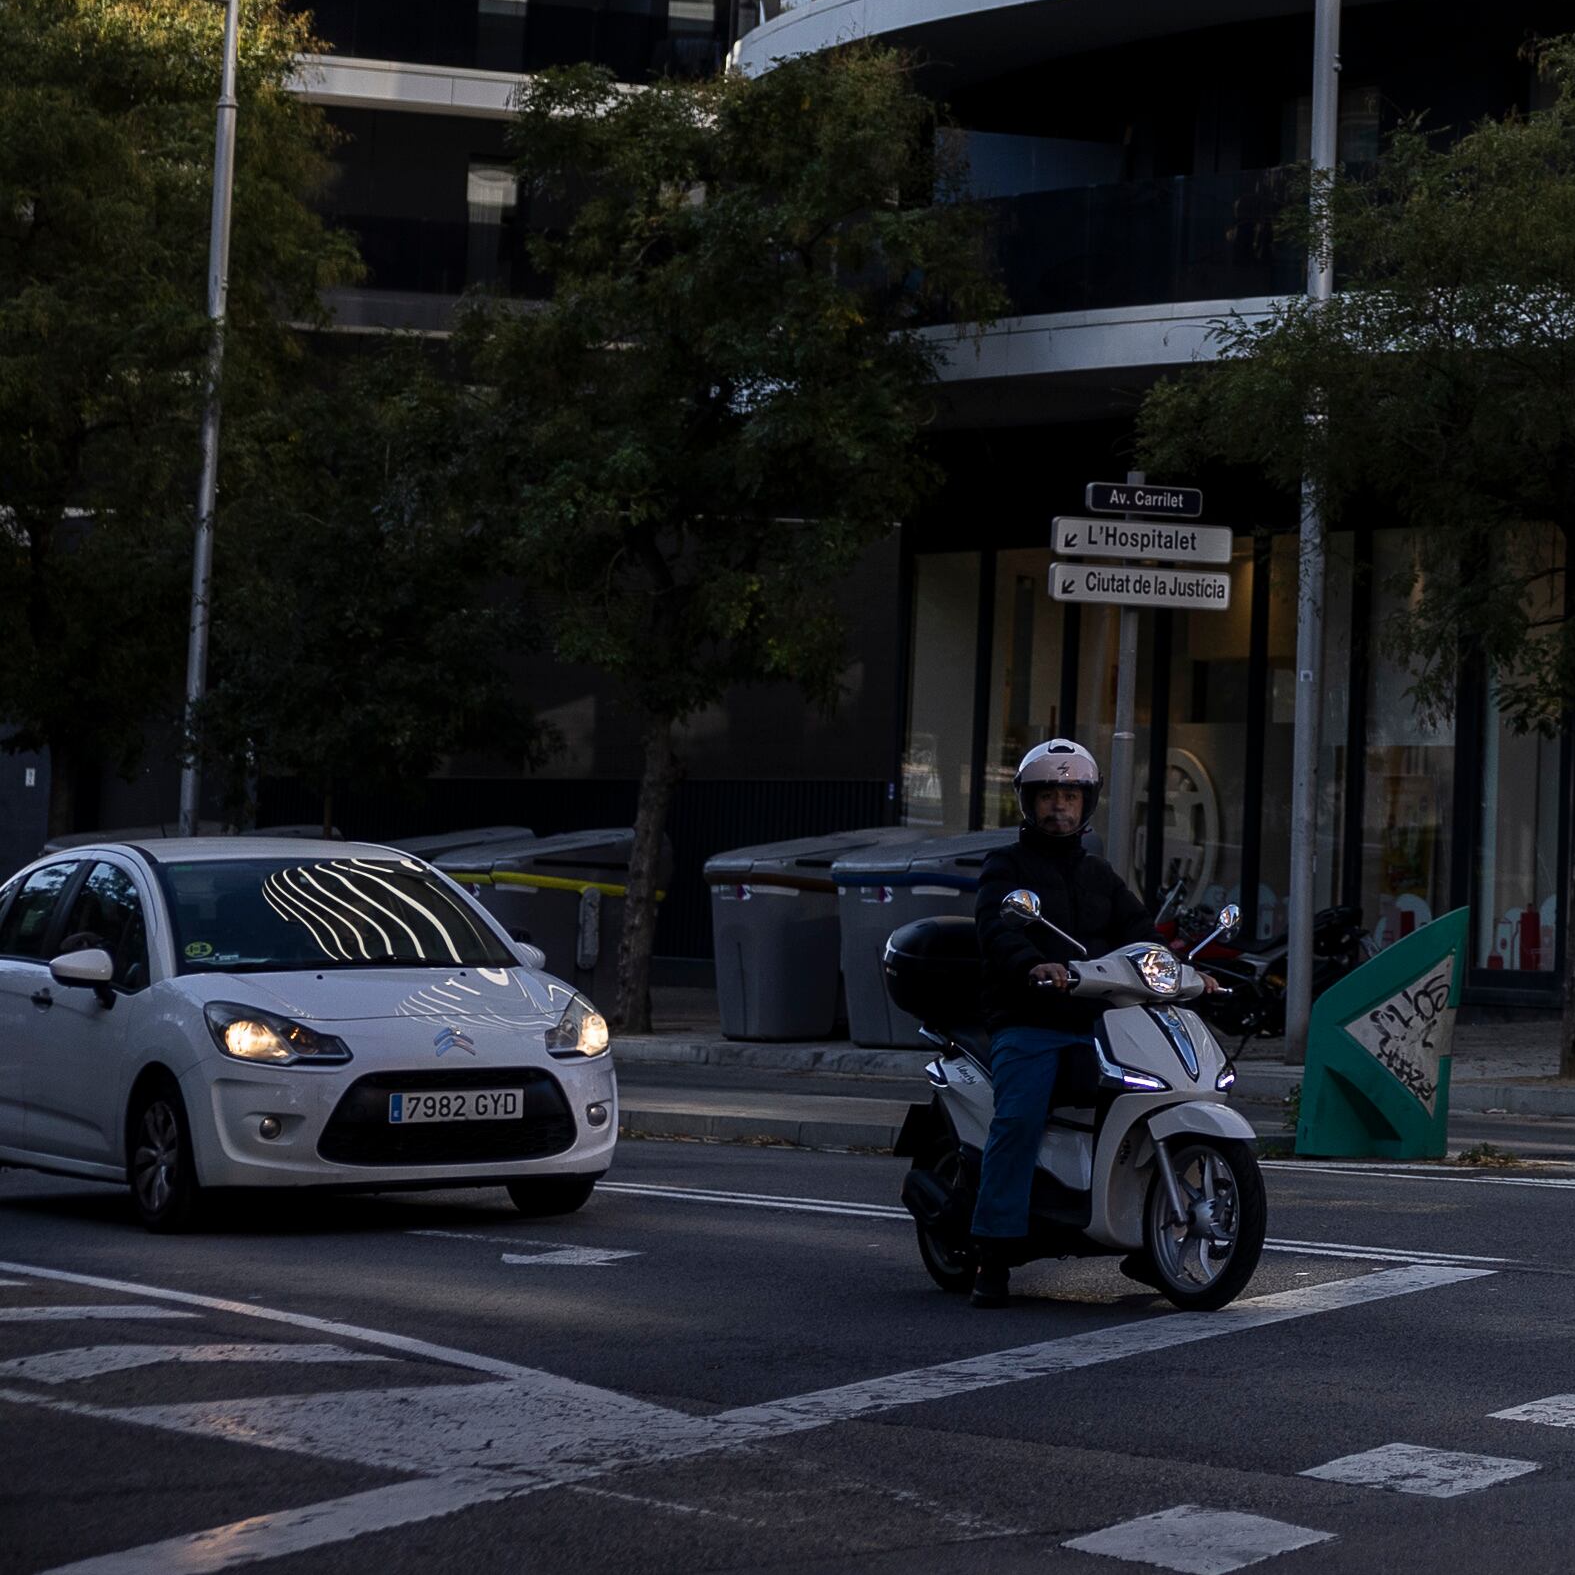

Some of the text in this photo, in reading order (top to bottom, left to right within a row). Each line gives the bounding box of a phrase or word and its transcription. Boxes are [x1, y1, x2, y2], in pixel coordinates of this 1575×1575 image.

[1109, 489, 1184, 508] Av. Carrilet
[1088, 525, 1197, 552] L'Hospitalet
[1085, 571, 1225, 599] Ciutat de la Justícia
[407, 1095, 467, 1120] 7982
[475, 1093, 517, 1116] GYD
